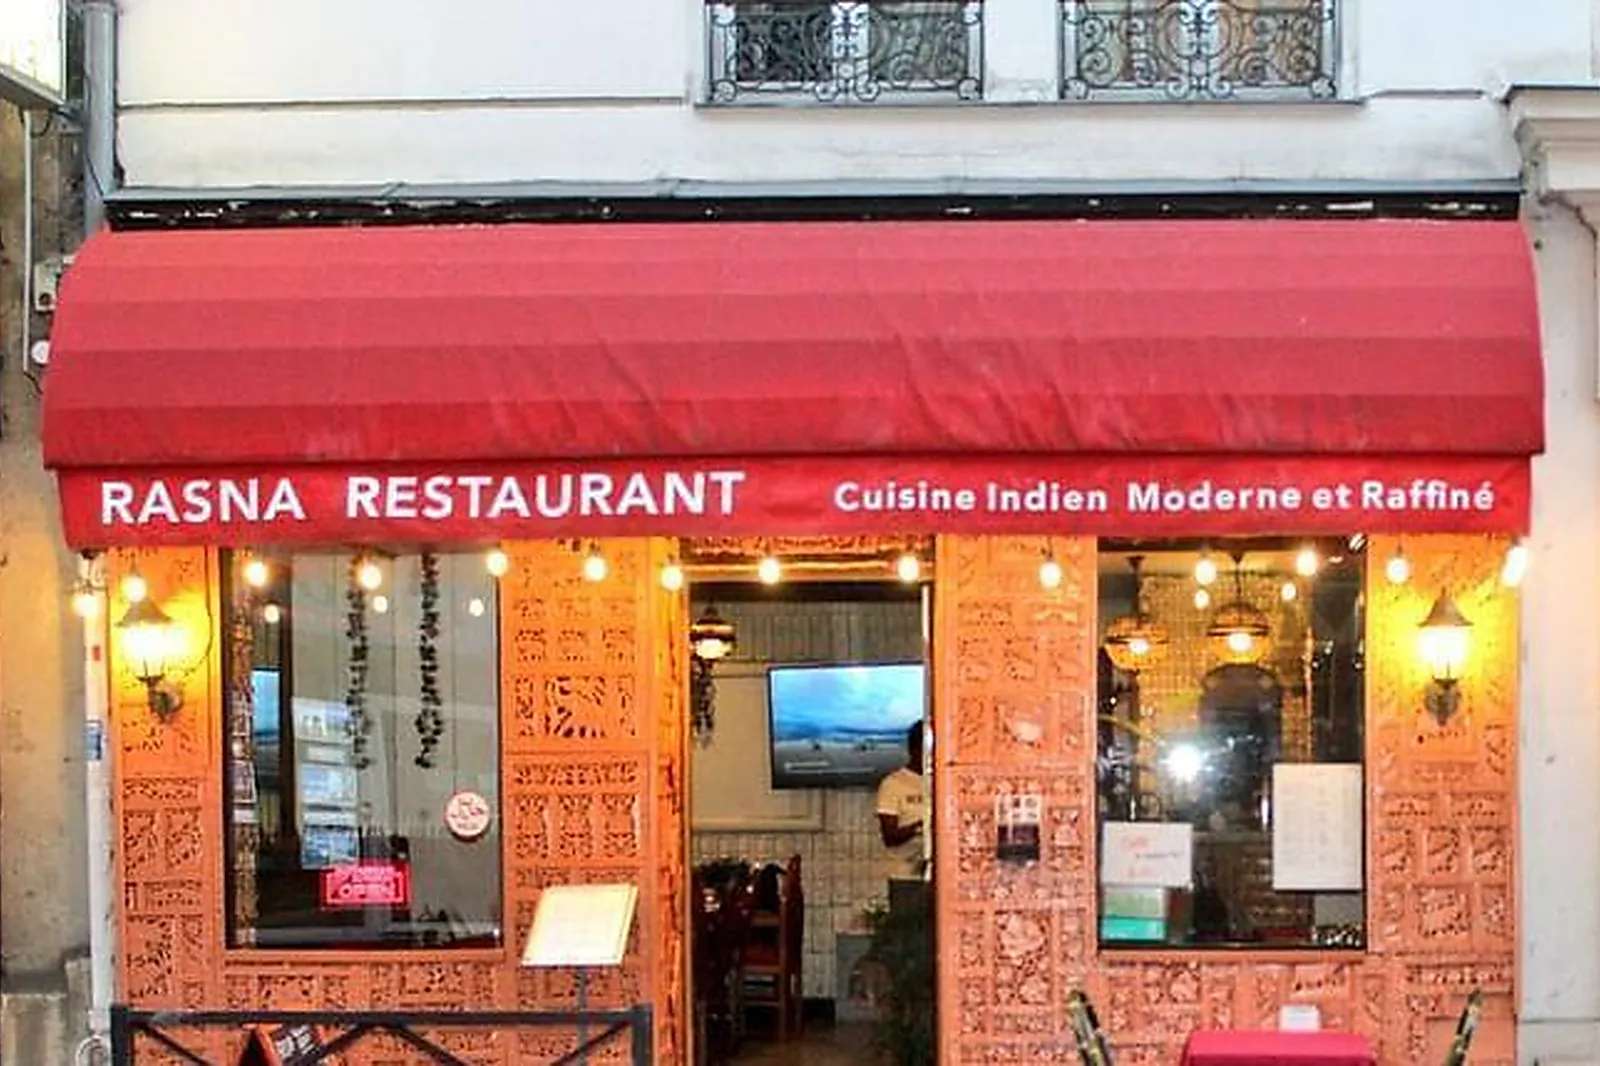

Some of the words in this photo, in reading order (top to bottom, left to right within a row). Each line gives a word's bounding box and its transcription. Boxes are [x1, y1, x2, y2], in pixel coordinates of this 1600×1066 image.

[102, 479, 305, 524] RASNA
[346, 472, 745, 518] RESTAURANT
[835, 481, 976, 511] Cuisine
[987, 481, 1107, 511] Indien
[1128, 481, 1301, 511] Moderne
[1312, 484, 1352, 509] et
[1361, 480, 1494, 510] Raffiné
